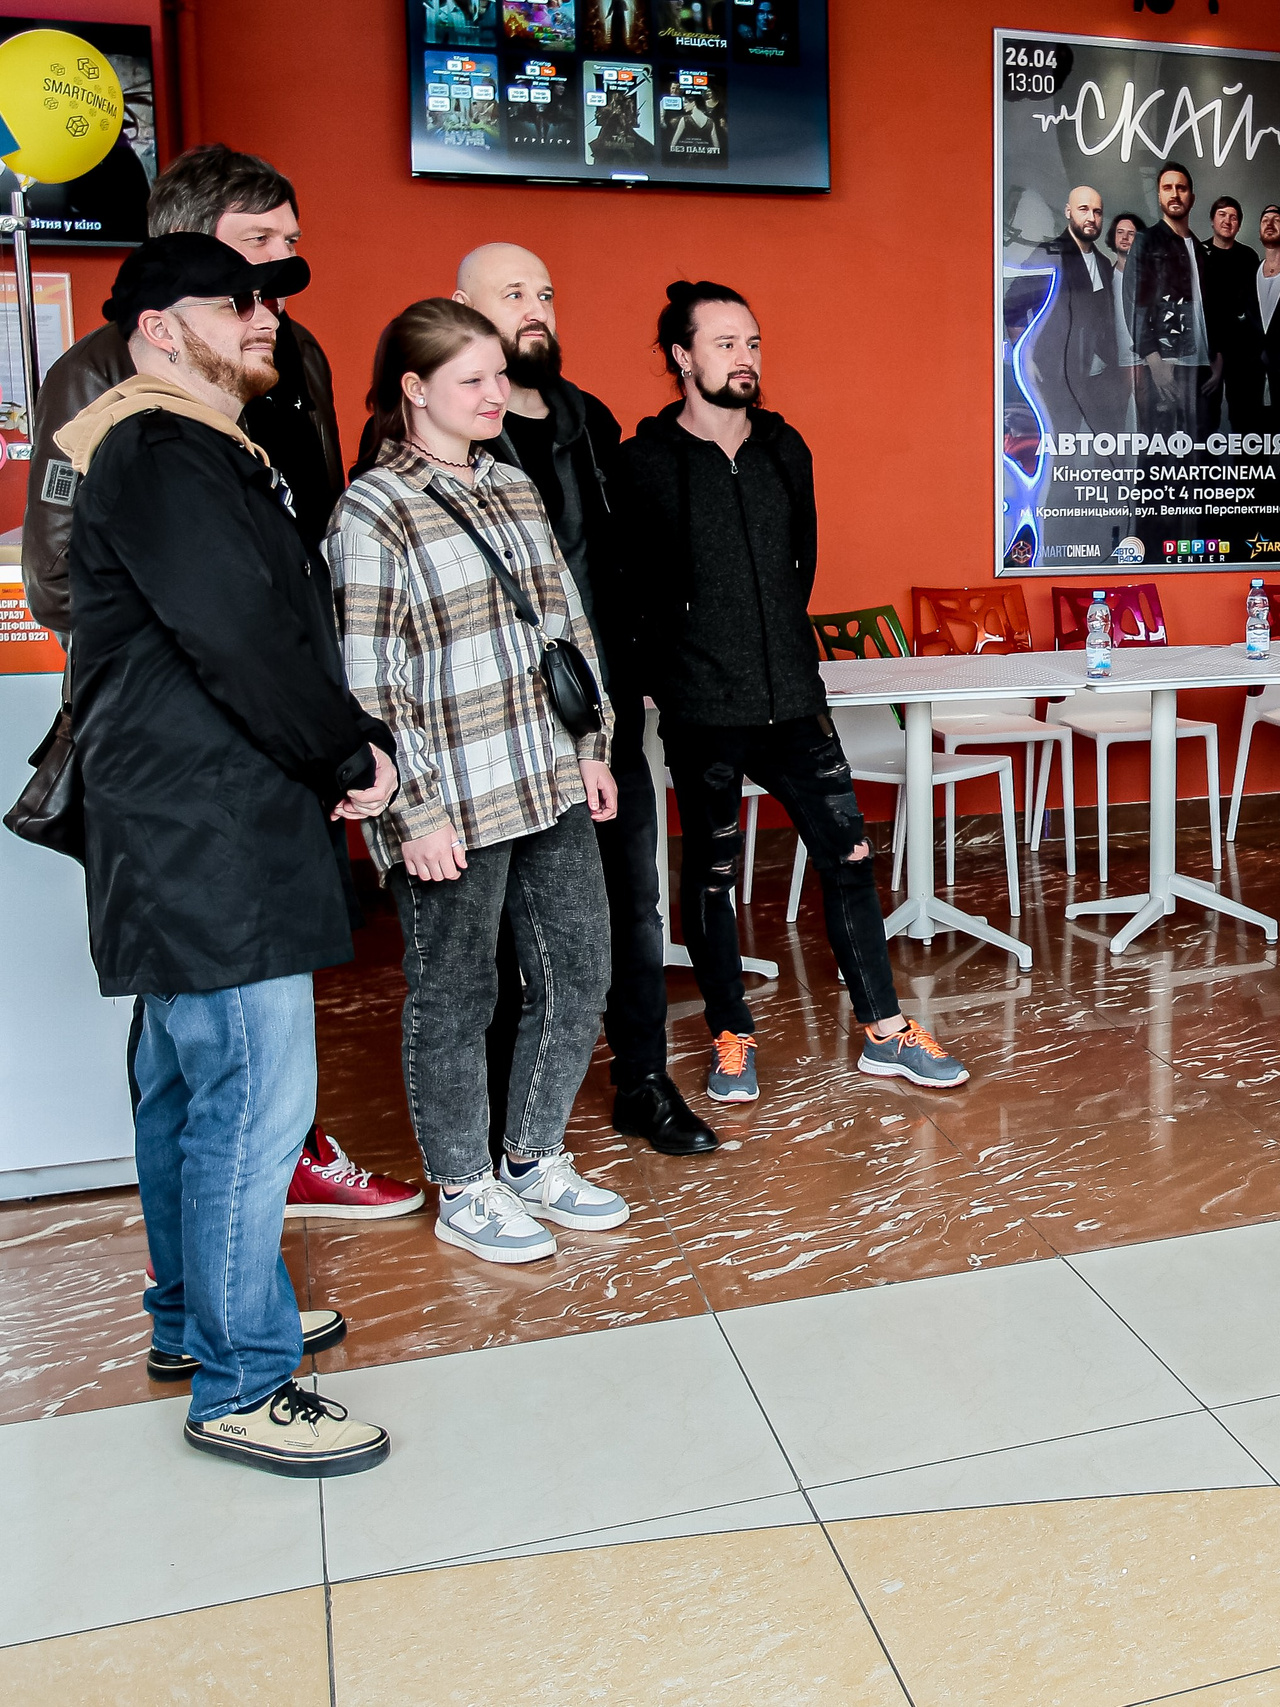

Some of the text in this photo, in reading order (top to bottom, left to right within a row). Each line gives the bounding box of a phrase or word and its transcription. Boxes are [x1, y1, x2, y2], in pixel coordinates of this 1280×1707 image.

[676, 37, 727, 48] НЕЩАСТЯ
[1005, 48, 1057, 68] 26.04
[1008, 73, 1055, 93] 13:00
[43, 77, 118, 119] SMARTCINEMA
[1074, 81, 1256, 168] СКАЙ
[30, 217, 102, 232] вітня у кіно
[1053, 465, 1276, 484] Кінотеатр SMARTCINEMA
[1074, 486, 1108, 503] ТРЦ
[1179, 486, 1189, 500] 4
[1194, 486, 1255, 502] поверх
[1036, 505, 1132, 519] Кропивницький,
[1135, 507, 1158, 518] вул.
[1160, 505, 1202, 515] Велика
[1166, 555, 1226, 564] CENTER
[11, 632, 27, 641] 028
[29, 632, 49, 641] 9221
[219, 1422, 247, 1436] NASA
